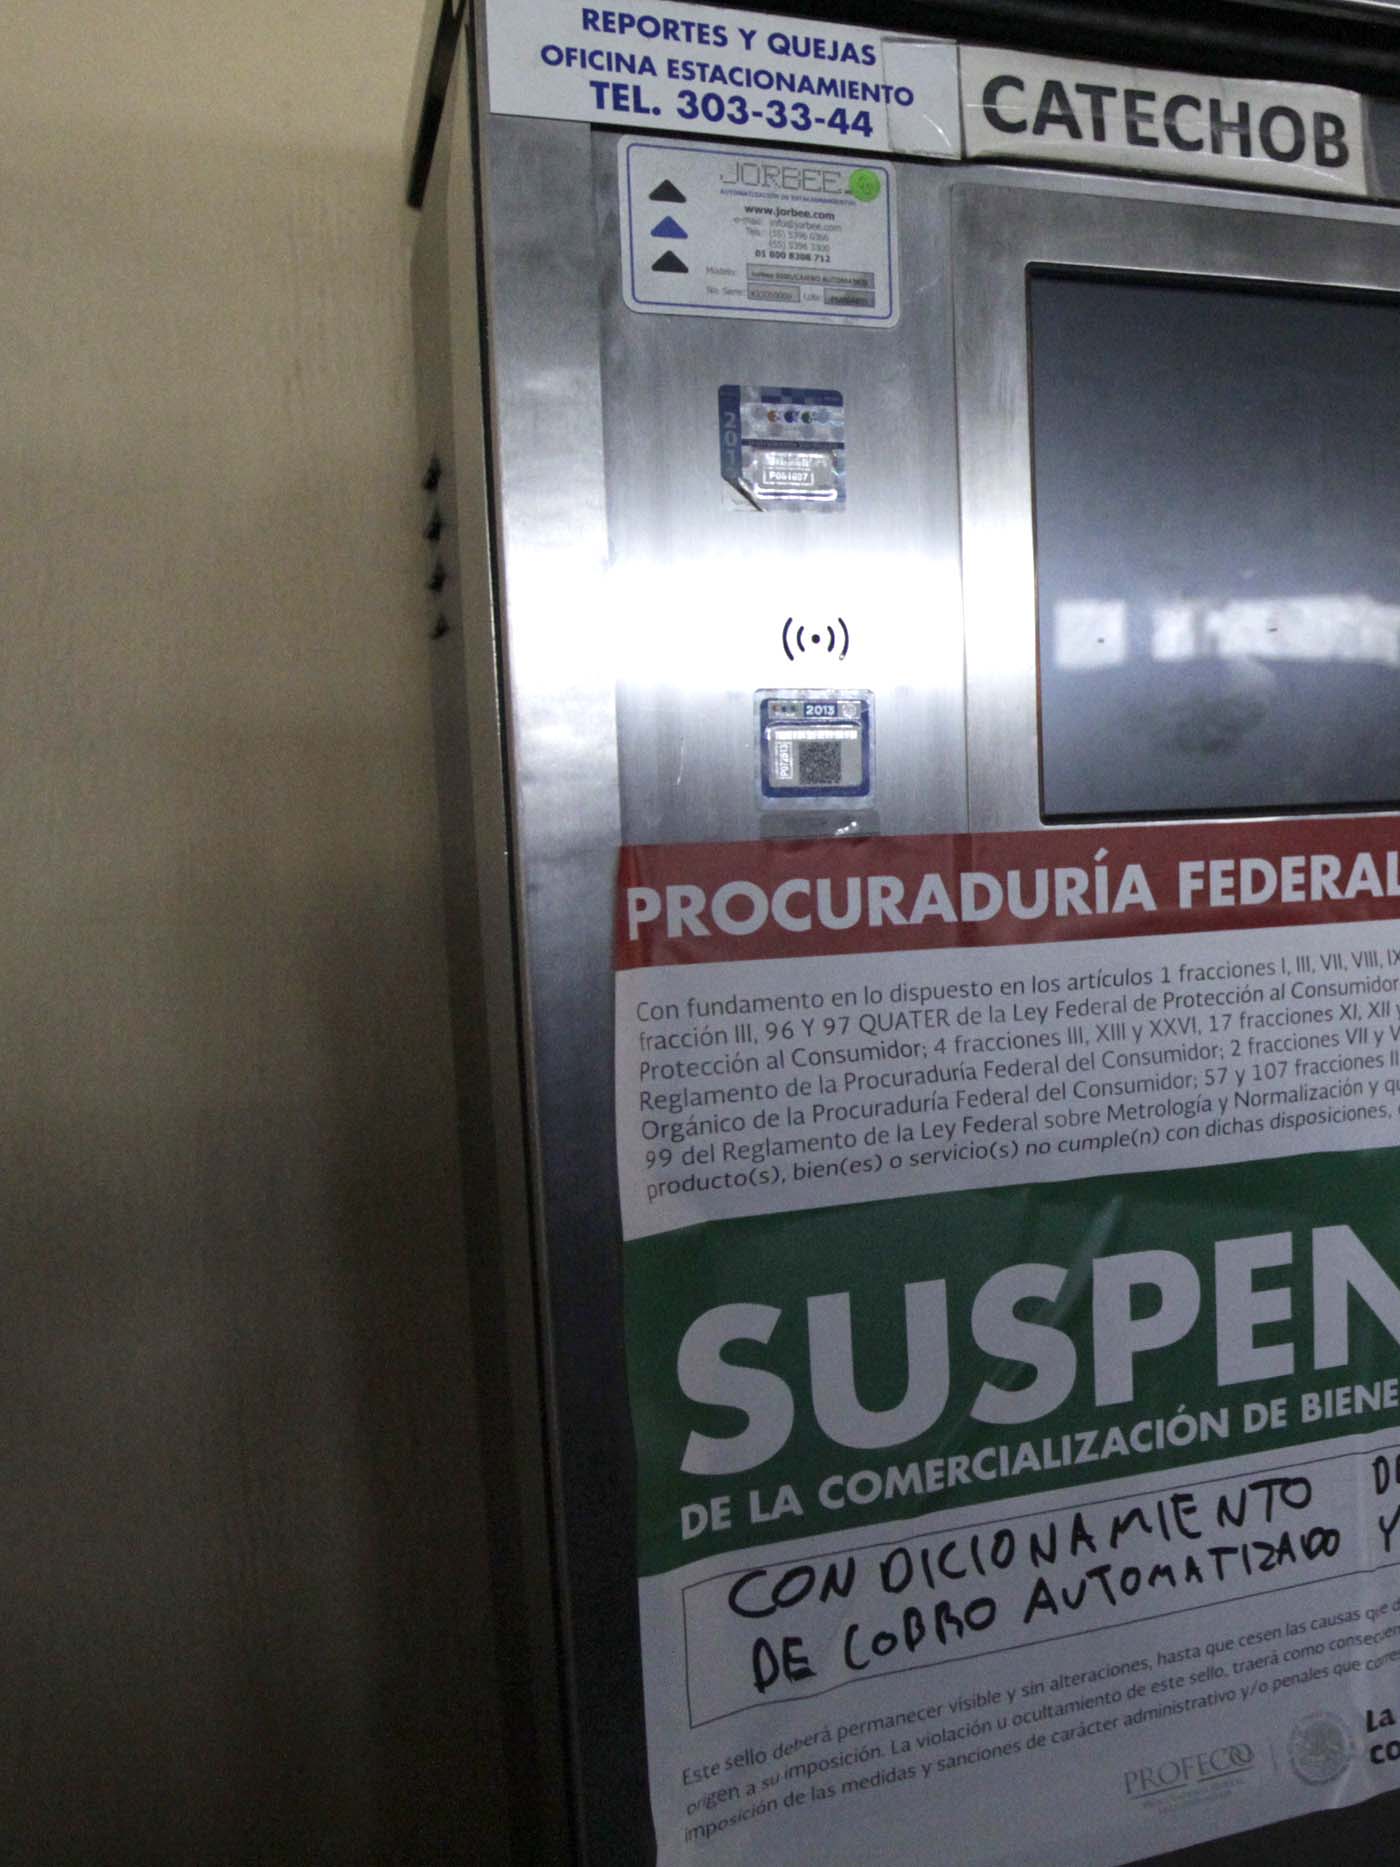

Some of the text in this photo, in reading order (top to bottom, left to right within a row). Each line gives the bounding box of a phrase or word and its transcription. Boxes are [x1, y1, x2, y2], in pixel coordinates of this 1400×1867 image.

[582, 8, 877, 66] REPORTES Y QUEJAS
[541, 44, 914, 107] OFICINA ESTACIONAMIENTO
[590, 80, 873, 138] TEL. 303-33-44
[980, 75, 1352, 169] CATECHOB
[744, 205, 835, 221] www.jorbee.com
[755, 249, 766, 259] 01
[806, 704, 836, 716] 2013
[626, 848, 1157, 941] PROCURADURÍA
[637, 1002, 679, 1022] Con
[687, 993, 824, 1017] fundamento
[890, 982, 992, 1005] dispuesto
[1067, 968, 1152, 991] artículos
[1179, 962, 1275, 982] fracciones
[640, 1030, 728, 1051] fracción
[859, 1009, 950, 1036] QUATER
[1014, 1004, 1048, 1024] Ley
[1056, 995, 1127, 1018] Federal
[1164, 989, 1264, 1009] Protección
[640, 1033, 1061, 1081] Protección Consumidor; fracciones
[640, 1085, 778, 1113] Reglamento
[845, 1062, 977, 1091] Procuraduría
[984, 1055, 1059, 1078] Federal
[1102, 1043, 1222, 1069] Consumidor;
[642, 1117, 745, 1142] Orgánico
[813, 1095, 948, 1123] Procuraduría
[957, 1085, 1028, 1108] Federal
[1073, 1072, 1197, 1099] Consumidor;
[1295, 1055, 1384, 1075] fracciones
[723, 1133, 856, 1163] Reglamento
[963, 1112, 1037, 1134] Federal
[1108, 1099, 1212, 1122] Metrología
[1234, 1082, 1363, 1107] Normalización
[647, 1166, 788, 1203] producto(s),
[794, 1154, 882, 1180] bien(es)
[910, 1140, 1018, 1167] servicio(s)
[1058, 1127, 1159, 1152] cumple(n)
[1205, 1118, 1264, 1137] dichas
[1270, 1105, 1391, 1131] disposiciones,
[680, 1496, 732, 1540] DE
[749, 1484, 804, 1525] LA
[818, 1404, 1230, 1510] COMERCIALIZACIÓN
[1244, 1404, 1287, 1434] DE
[752, 1637, 816, 1694] DE
[844, 1597, 997, 1671] COBRO
[1023, 1526, 1340, 1624] AUTOMATIZADO
[683, 1763, 720, 1786] Este
[725, 1748, 766, 1770] sello
[837, 1705, 942, 1743] permanecer
[949, 1690, 1001, 1713] visible
[1007, 1689, 1016, 1703] y
[1021, 1681, 1044, 1697] sin
[1050, 1659, 1152, 1691] alteraciones,
[1157, 1647, 1201, 1665] hasta
[1206, 1640, 1234, 1656] que
[1238, 1628, 1281, 1647] cesen
[1286, 1622, 1306, 1636] las
[1310, 1610, 1360, 1630] causas
[746, 1784, 755, 1796] a
[891, 1741, 911, 1755] La
[916, 1720, 992, 1748] violación
[1012, 1691, 1122, 1726] ocultamiento
[1127, 1684, 1146, 1700] de
[1151, 1677, 1184, 1693] este
[1233, 1654, 1279, 1674] traerá
[1283, 1644, 1325, 1662] como
[1366, 1708, 1395, 1733] La
[685, 1800, 778, 1842] imposición
[783, 1792, 805, 1808] de
[811, 1786, 836, 1801] las
[842, 1767, 916, 1793] medidas
[921, 1763, 932, 1778] y
[937, 1742, 1021, 1771] sanciones
[1026, 1734, 1046, 1749] de
[1051, 1718, 1118, 1743] carácter
[1124, 1690, 1235, 1727] administrativo
[1240, 1680, 1269, 1701] y/o
[1272, 1667, 1329, 1693] penales
[1333, 1661, 1360, 1677] que
